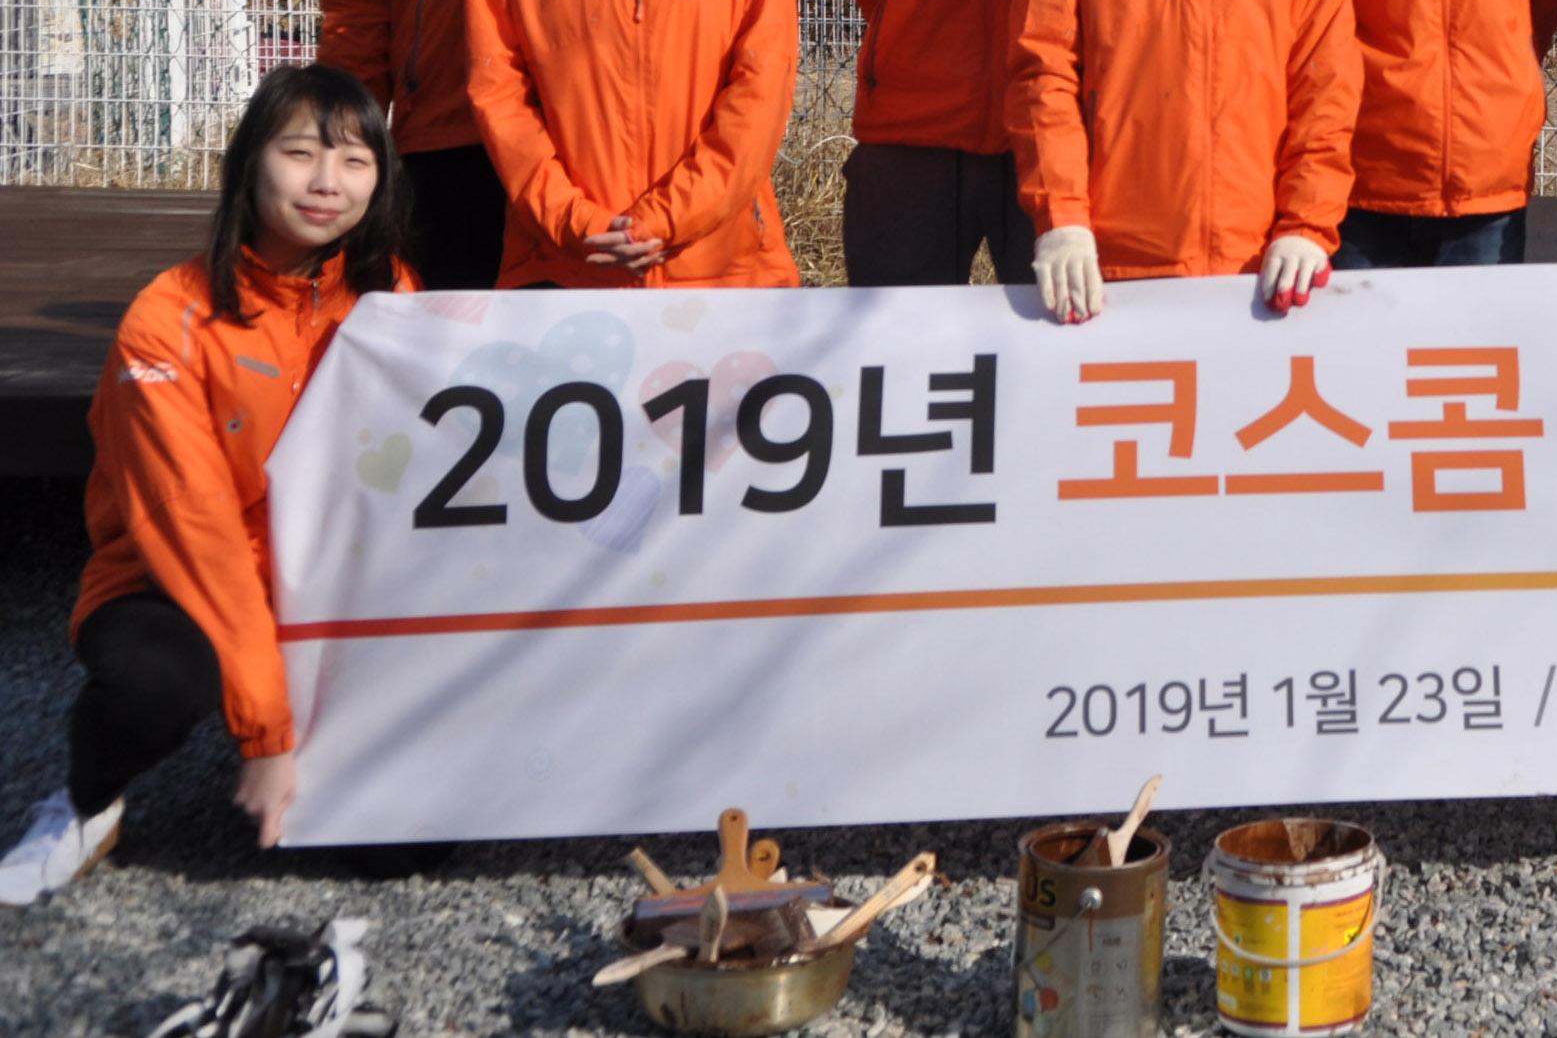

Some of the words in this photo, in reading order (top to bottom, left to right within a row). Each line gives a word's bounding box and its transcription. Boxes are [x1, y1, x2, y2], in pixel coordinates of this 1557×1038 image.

[414, 355, 997, 528] 2019년
[1060, 349, 1542, 512] 코스콤
[1046, 673, 1249, 738] 2019년
[1273, 668, 1358, 735] 1월
[1379, 664, 1503, 730] 23일
